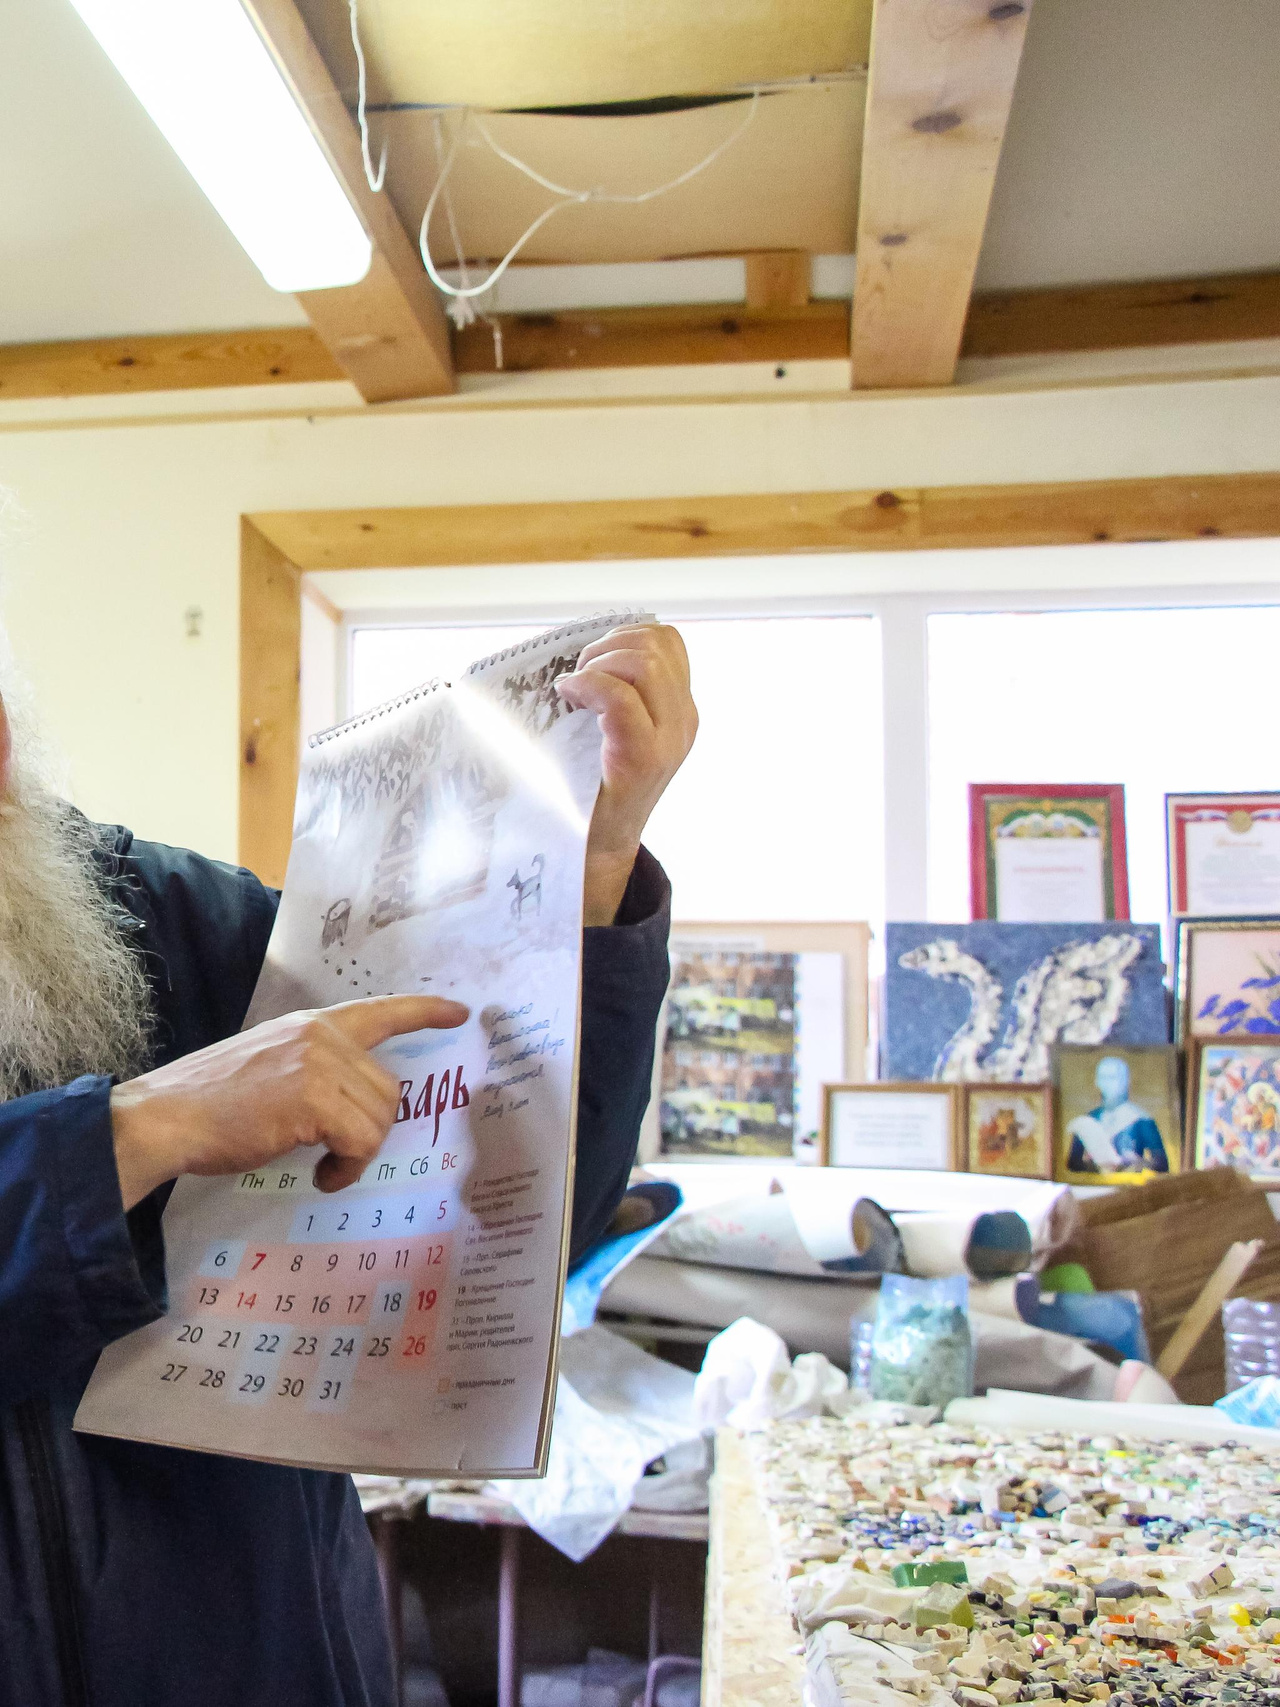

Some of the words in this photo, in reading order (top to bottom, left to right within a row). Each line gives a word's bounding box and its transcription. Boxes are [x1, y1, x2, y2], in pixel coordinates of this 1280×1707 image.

[394, 1065, 469, 1147] варь
[242, 1174, 264, 1188] Пн
[279, 1174, 297, 1188] Вт
[378, 1164, 396, 1180] Пт
[410, 1156, 429, 1175] Сб
[441, 1153, 457, 1170] Вс
[307, 1215, 313, 1231] 1
[337, 1213, 349, 1230] 2
[372, 1210, 382, 1227] 3
[405, 1206, 414, 1223] 4
[437, 1201, 447, 1219] 5
[215, 1251, 228, 1266] 6
[251, 1253, 266, 1270] 7
[291, 1255, 303, 1272] 8
[327, 1254, 338, 1271] 9
[358, 1253, 376, 1270] 10
[395, 1250, 409, 1268] 11
[427, 1246, 443, 1265] 12
[199, 1288, 219, 1304] 13
[236, 1292, 257, 1309] 14
[275, 1295, 295, 1312] 15
[311, 1296, 330, 1313] 16
[347, 1295, 366, 1313] 17
[383, 1293, 401, 1312] 18
[418, 1290, 437, 1310] 19
[458, 1286, 466, 1294] 19
[177, 1325, 203, 1343] 20
[218, 1331, 241, 1348] 21
[254, 1335, 279, 1353] 22
[293, 1337, 318, 1355] 23
[330, 1338, 354, 1356] 24
[367, 1337, 391, 1356] 25
[402, 1337, 425, 1356] 26
[161, 1364, 187, 1382] 27
[199, 1369, 225, 1388] 28
[239, 1374, 266, 1392] 29
[278, 1379, 304, 1397] 30
[319, 1381, 342, 1399] 31
